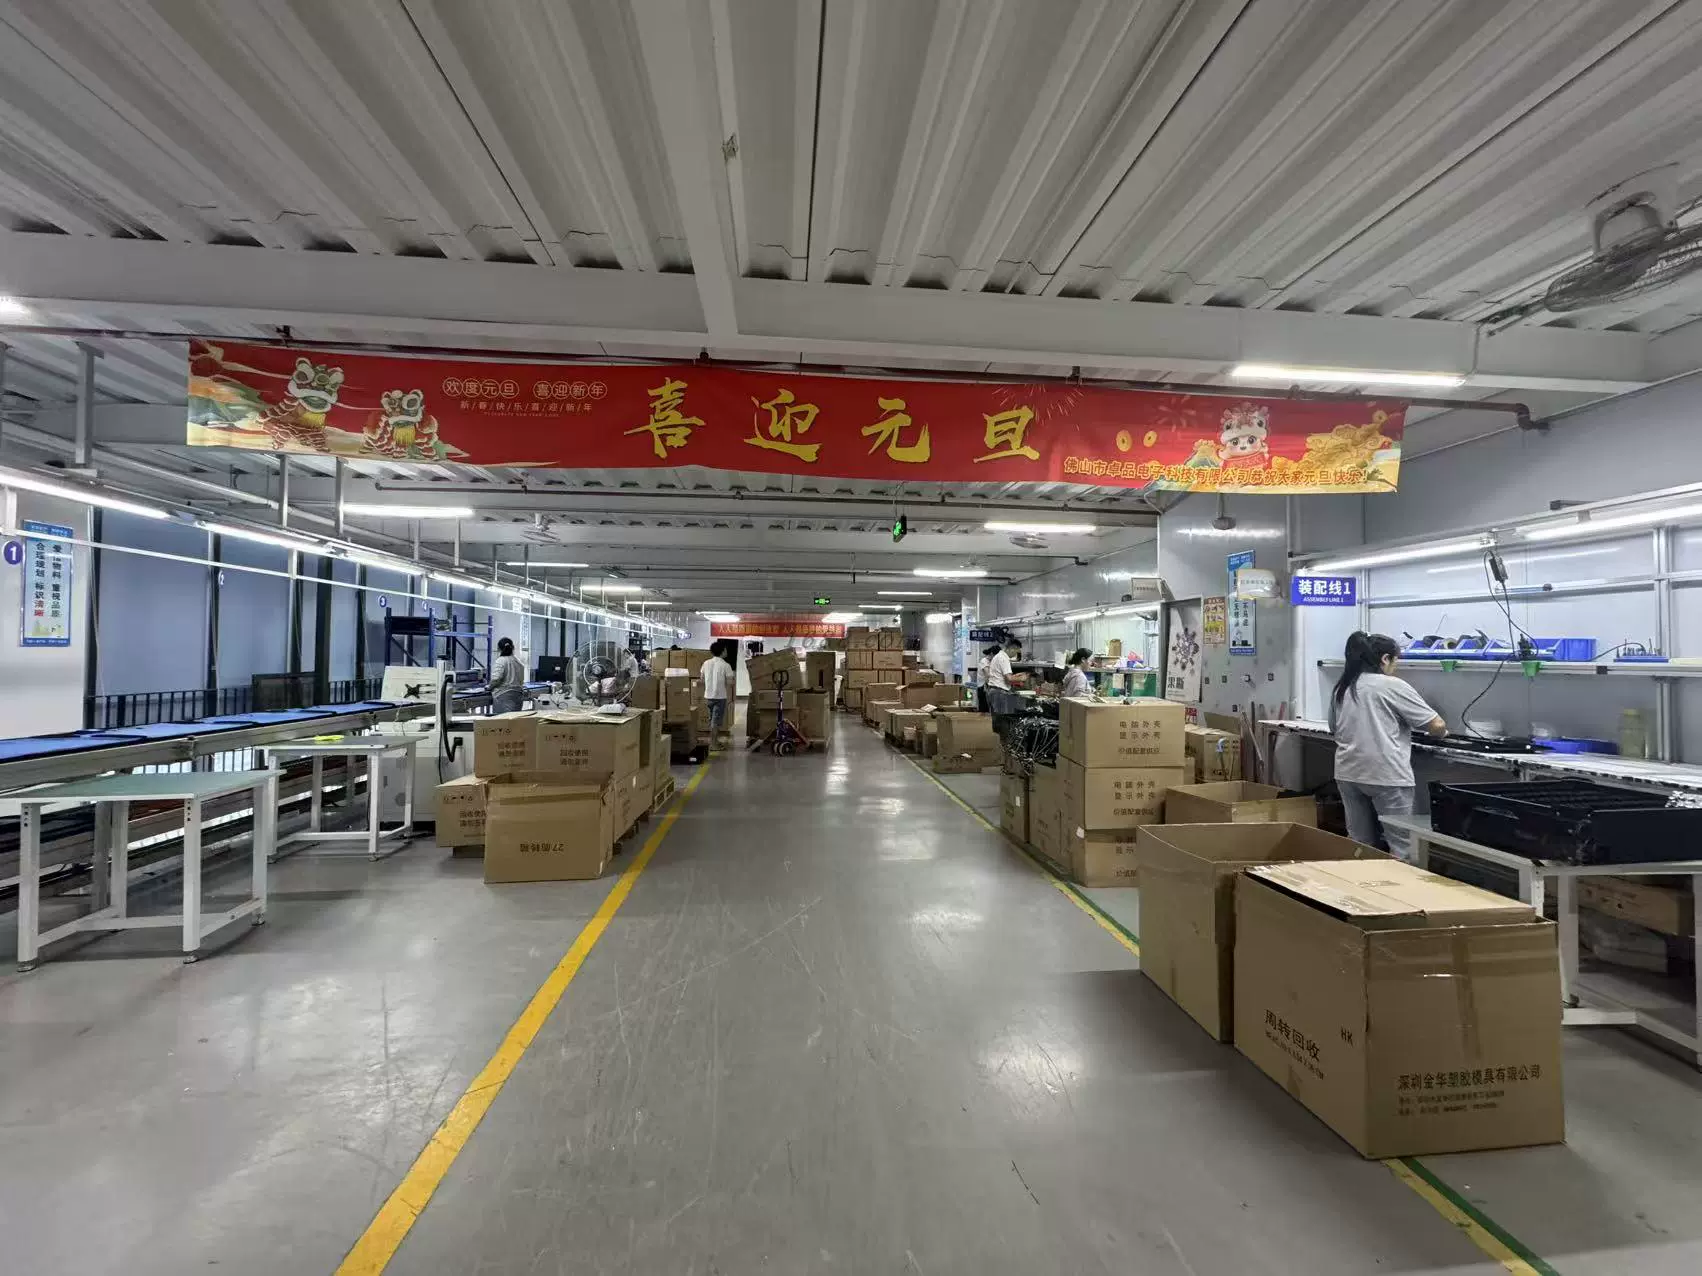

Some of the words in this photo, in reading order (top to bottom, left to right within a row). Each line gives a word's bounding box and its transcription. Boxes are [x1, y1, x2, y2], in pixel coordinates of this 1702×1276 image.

[443, 377, 520, 399] 欢度元旦
[533, 380, 608, 399] 喜迎新年
[623, 377, 1041, 464] 喜迎元旦
[1298, 579, 1351, 596] 装配线1
